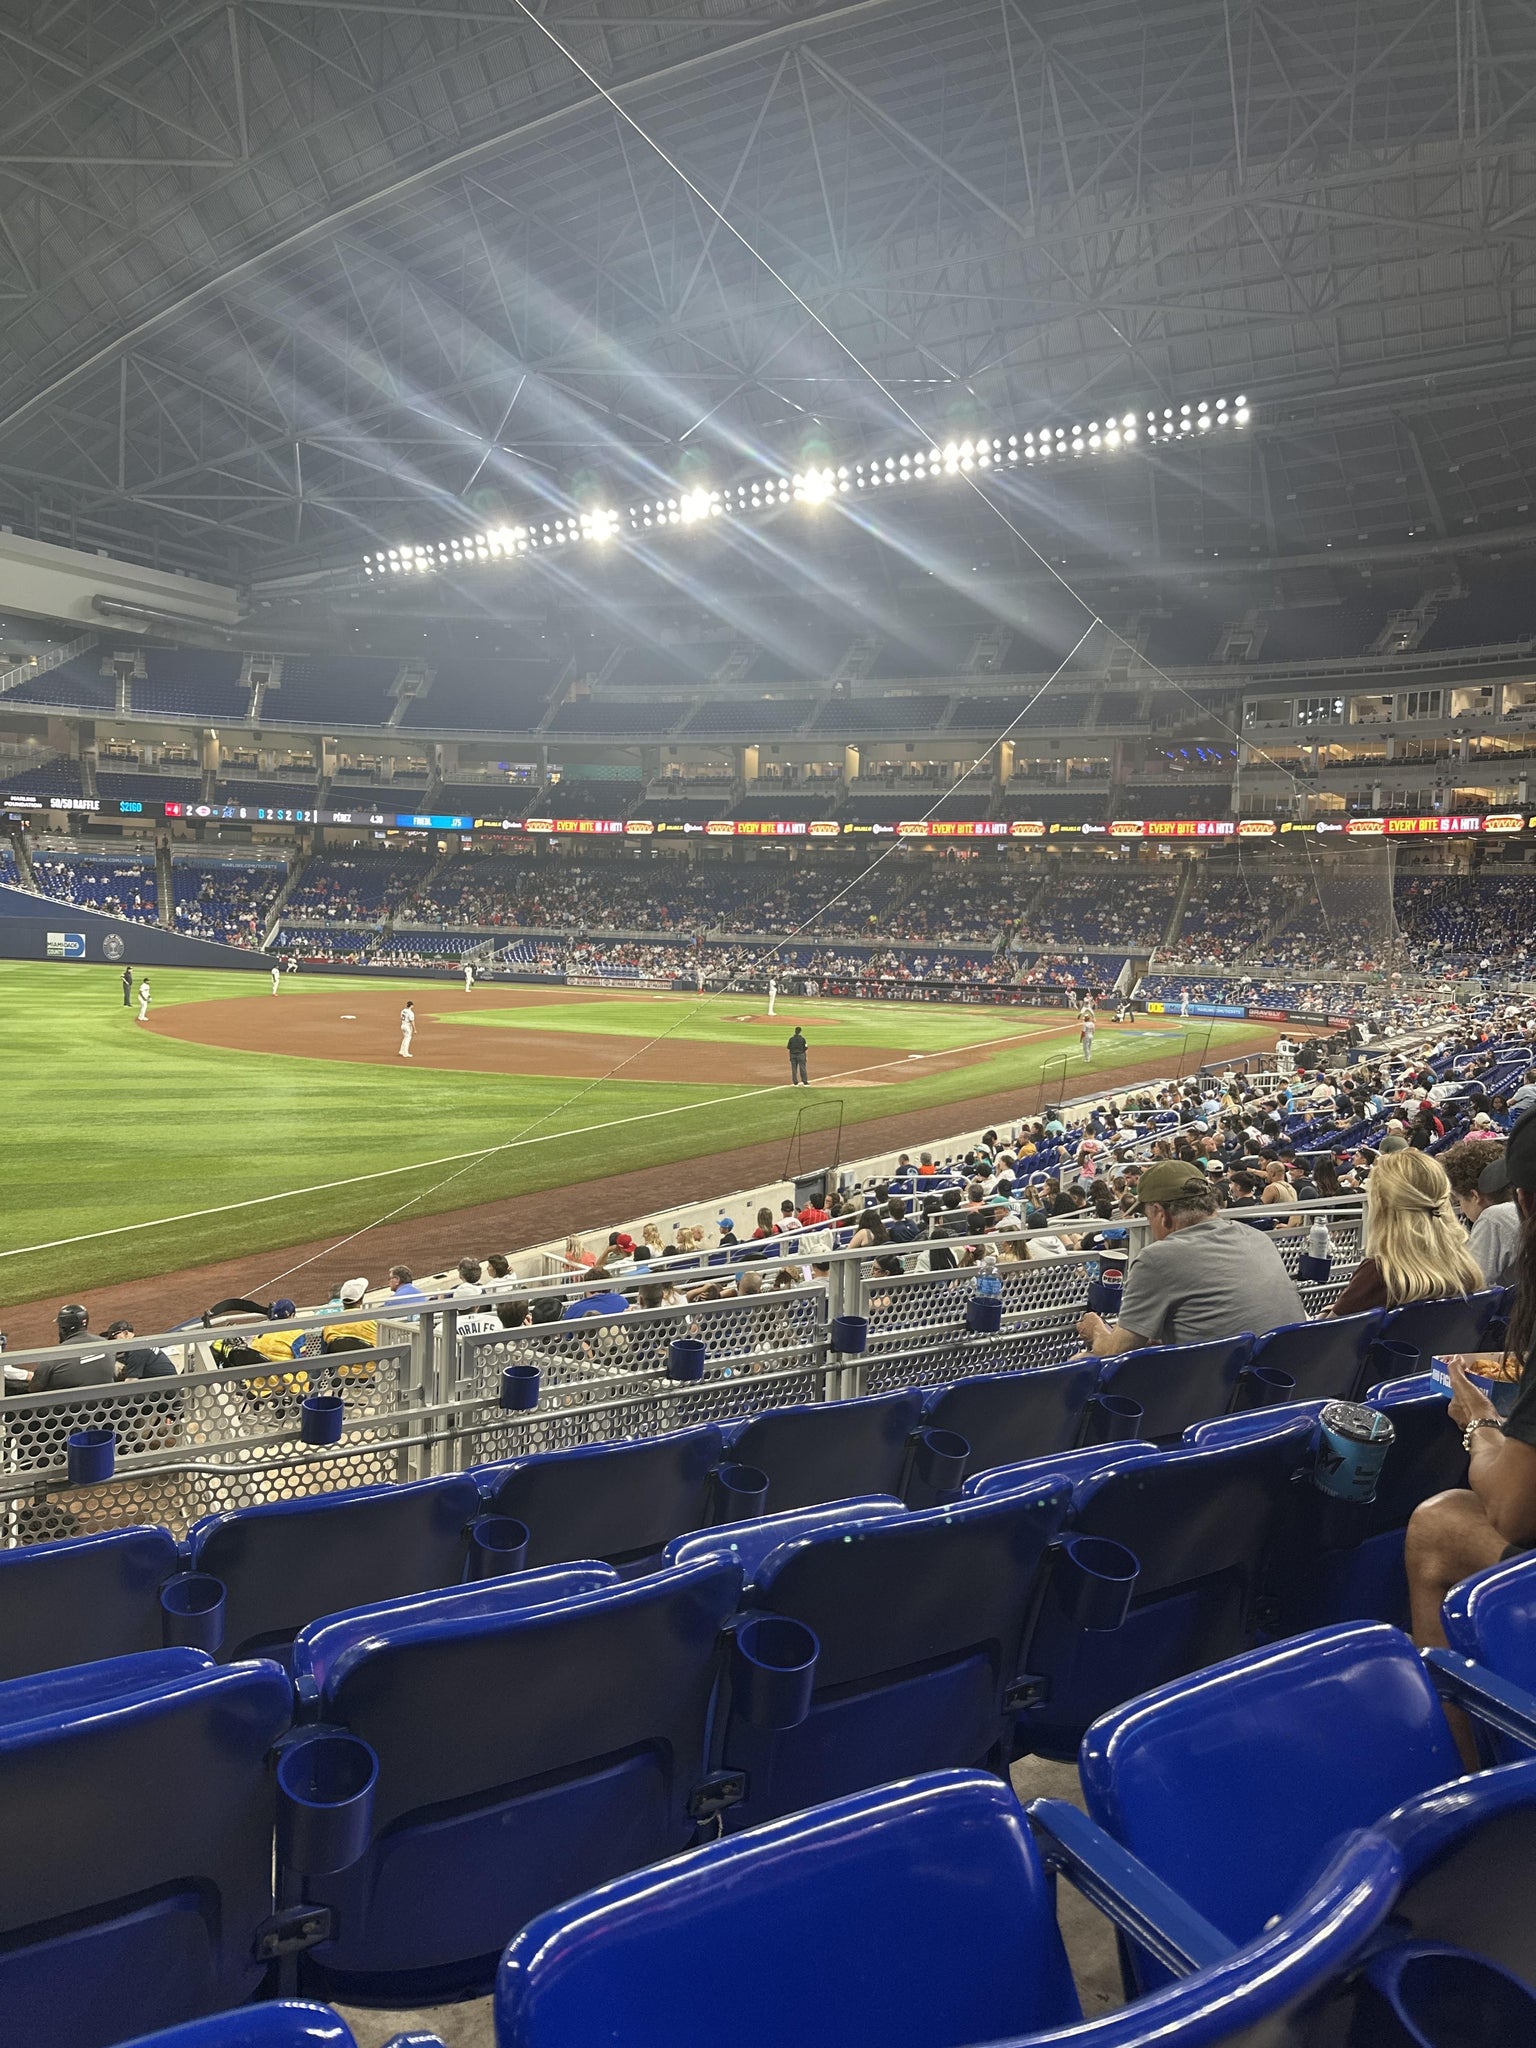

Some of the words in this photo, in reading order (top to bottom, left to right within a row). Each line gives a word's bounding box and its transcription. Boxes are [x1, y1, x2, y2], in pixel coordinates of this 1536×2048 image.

[50, 797, 73, 809] 50/50
[73, 799, 100, 811] RAFFLE
[120, 801, 143, 813] $2160
[186, 804, 193, 816] 2
[266, 808, 273, 820] 2
[285, 809, 292, 821] 2
[304, 811, 311, 822] 2
[557, 821, 577, 831] EVERY
[579, 821, 594, 831] BITE
[738, 823, 759, 833] EVERY
[761, 823, 776, 833] BITE
[932, 824, 955, 834] EVERY
[957, 824, 974, 834] BITE
[1149, 823, 1175, 834] EVERY
[1177, 823, 1196, 834] BITE
[1388, 820, 1417, 832] EVERY
[1419, 819, 1438, 831] BITE
[1460, 818, 1480, 830] HIT!
[1248, 1008, 1281, 1017] GRAVELY
[457, 1322, 495, 1336] ORALES
